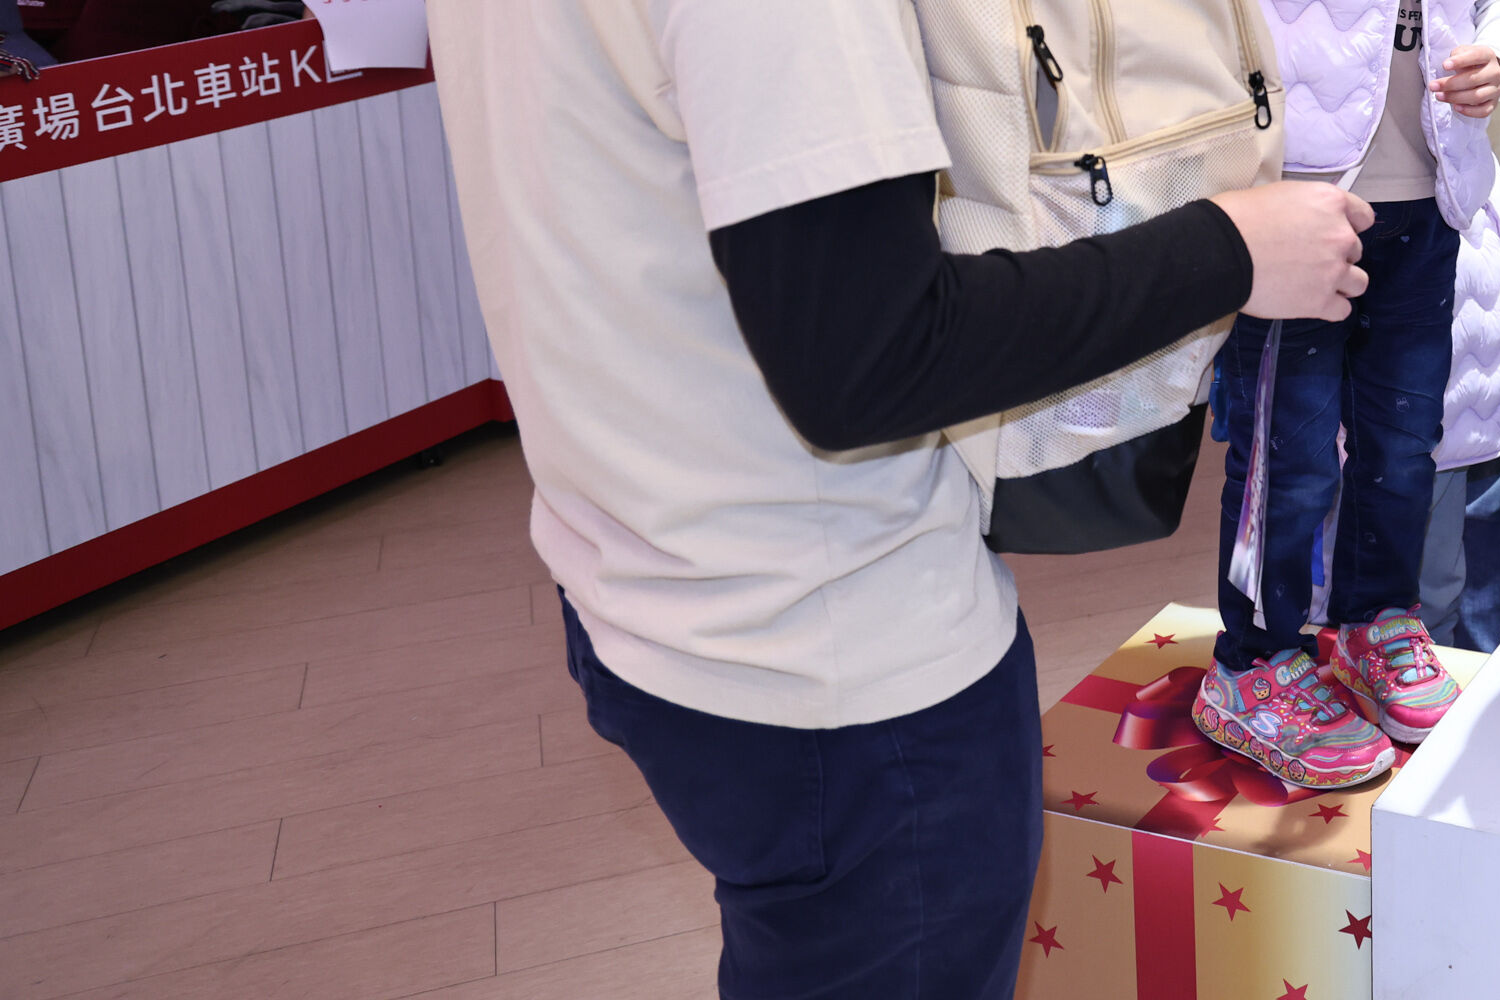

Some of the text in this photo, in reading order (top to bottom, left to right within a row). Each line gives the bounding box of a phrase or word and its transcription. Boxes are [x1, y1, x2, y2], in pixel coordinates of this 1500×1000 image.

[0, 43, 363, 153] 廣場台北車站K
